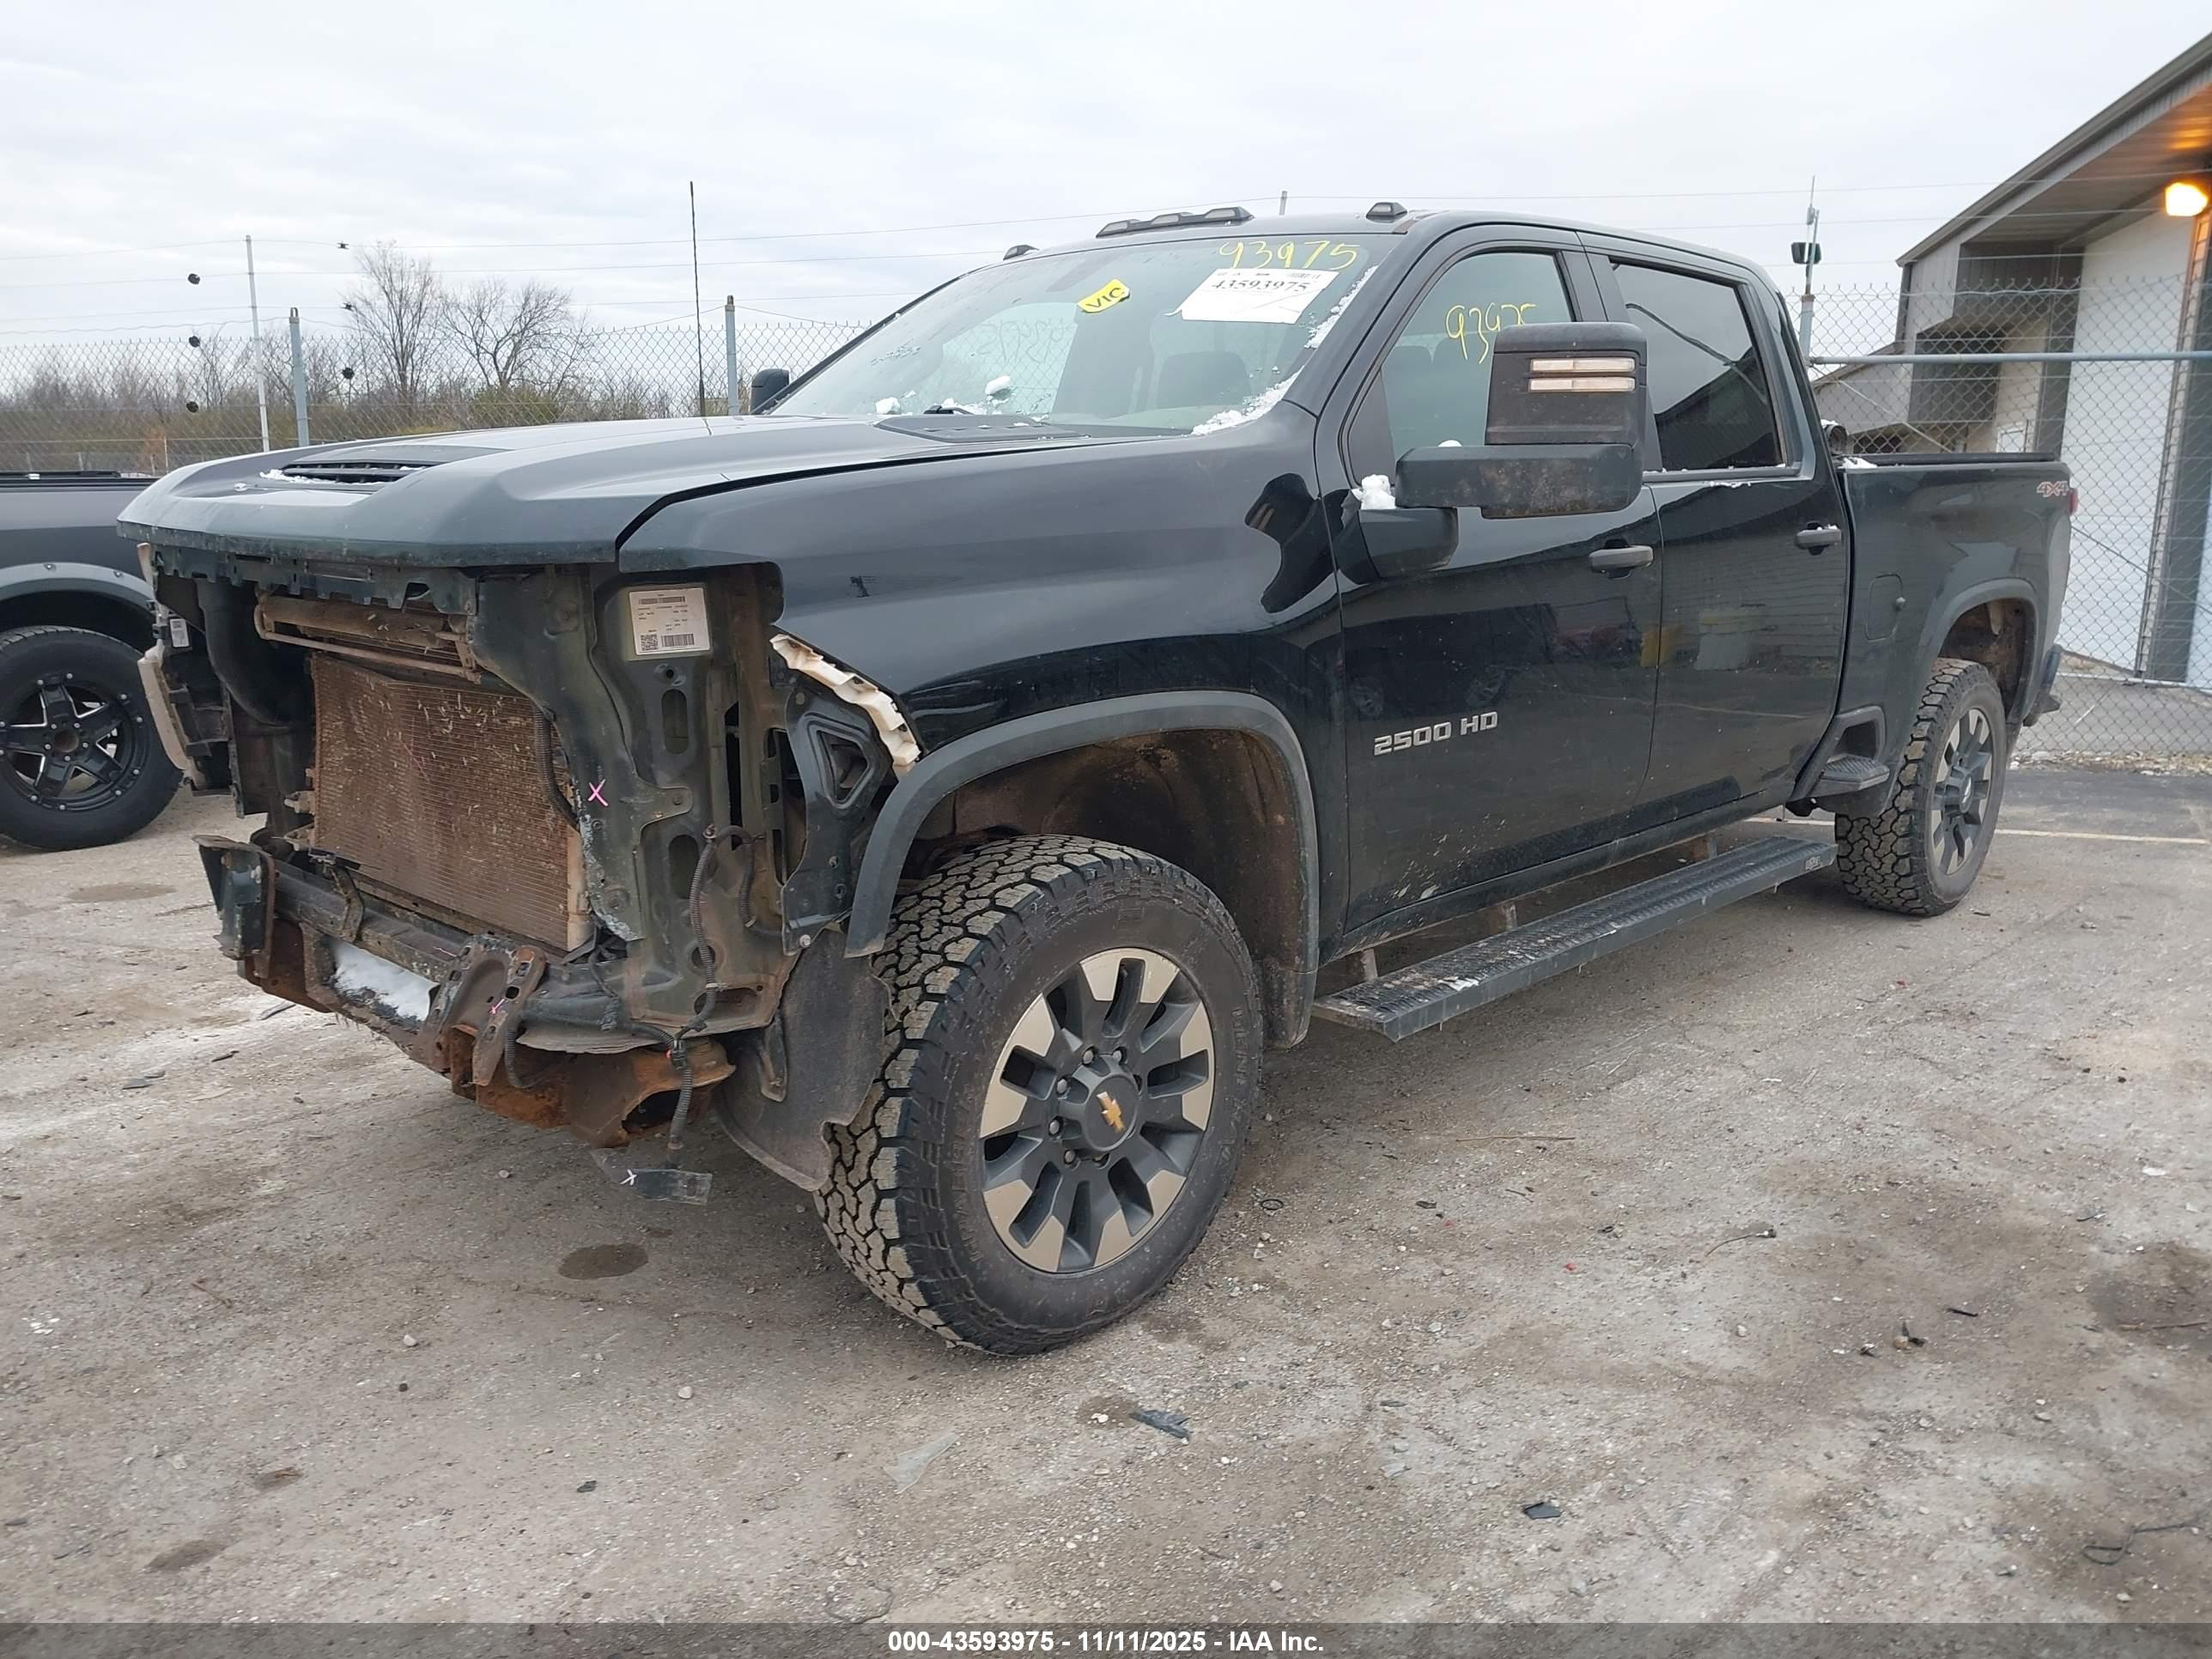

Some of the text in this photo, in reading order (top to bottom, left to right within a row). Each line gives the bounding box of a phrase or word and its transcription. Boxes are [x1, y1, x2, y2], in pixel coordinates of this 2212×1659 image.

[1219, 240, 1359, 270] 93975
[1085, 286, 1125, 311] VIC
[1211, 278, 1312, 292] 43593975
[1374, 711, 1498, 756] 2500 HD
